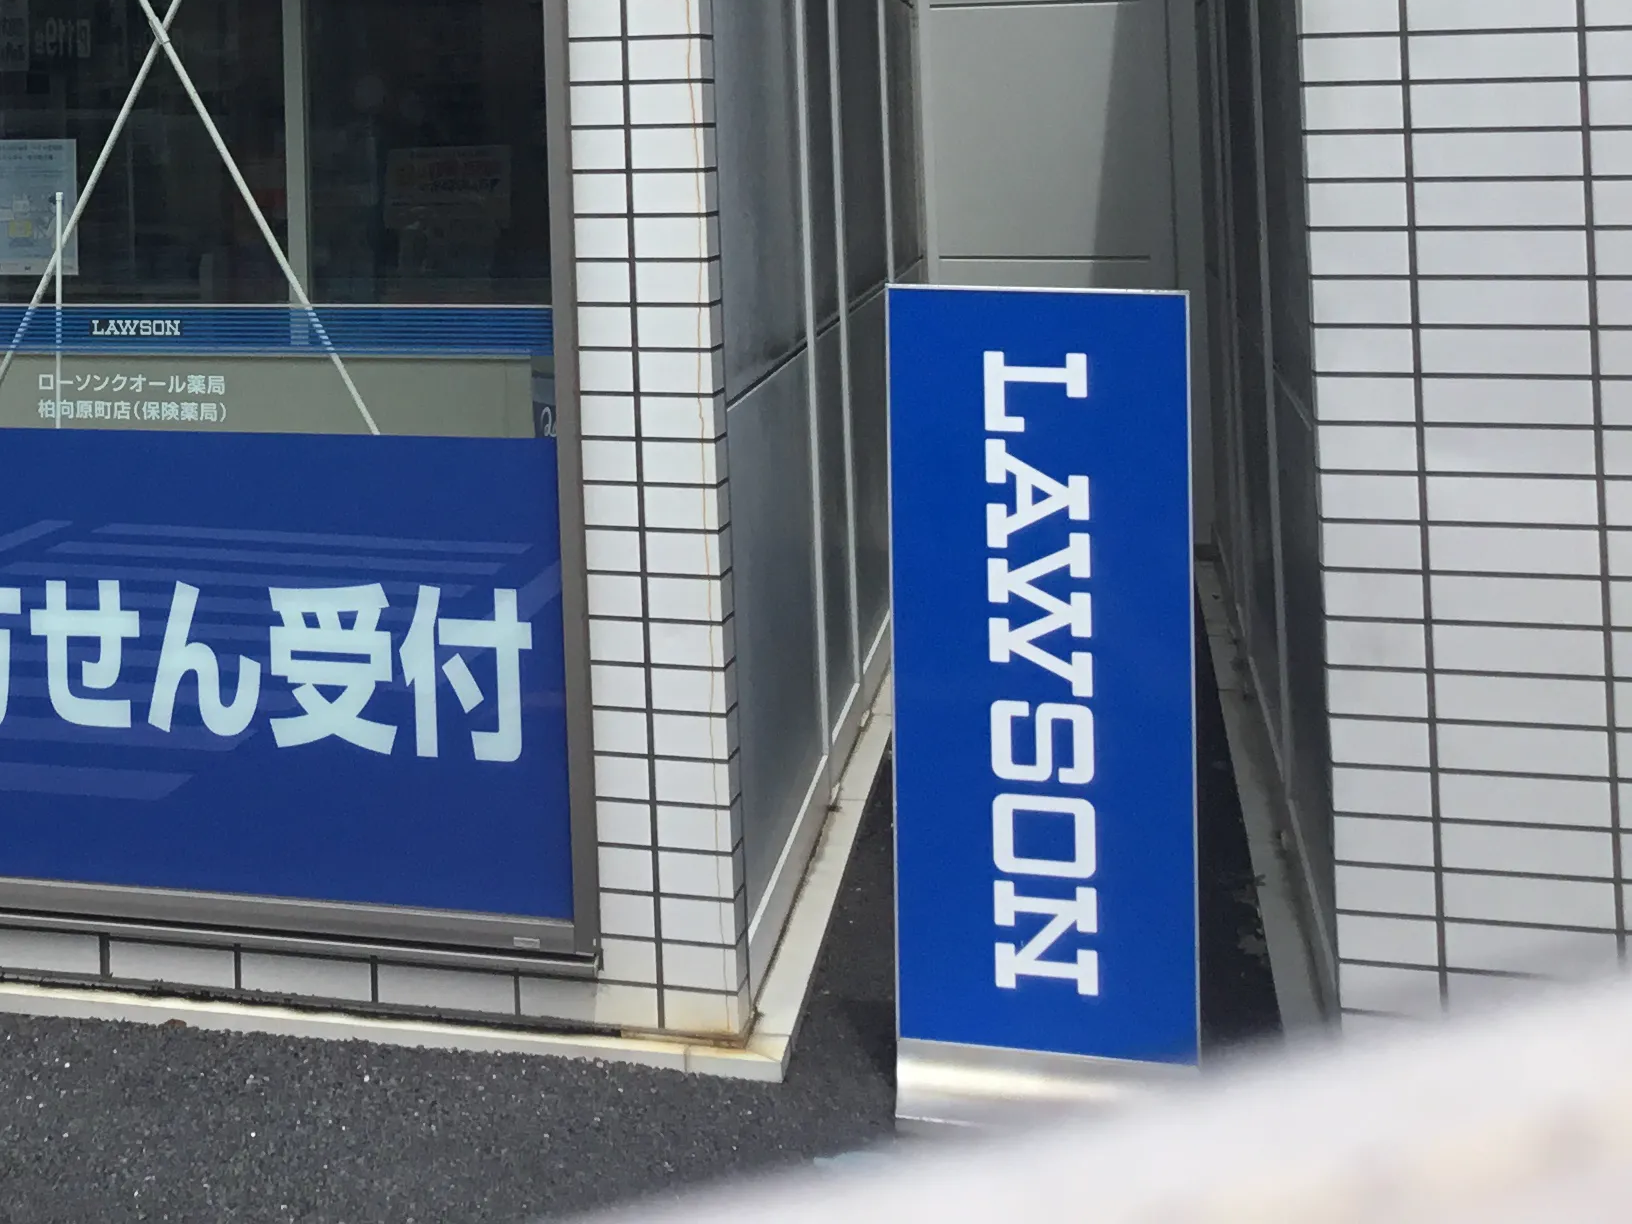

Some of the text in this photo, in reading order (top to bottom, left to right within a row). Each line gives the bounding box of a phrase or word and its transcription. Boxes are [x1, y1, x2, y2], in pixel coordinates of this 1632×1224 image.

[91, 319, 181, 336] LAWSON
[38, 373, 226, 396] ローソンクオール薬局
[983, 350, 1099, 997] LAWSON
